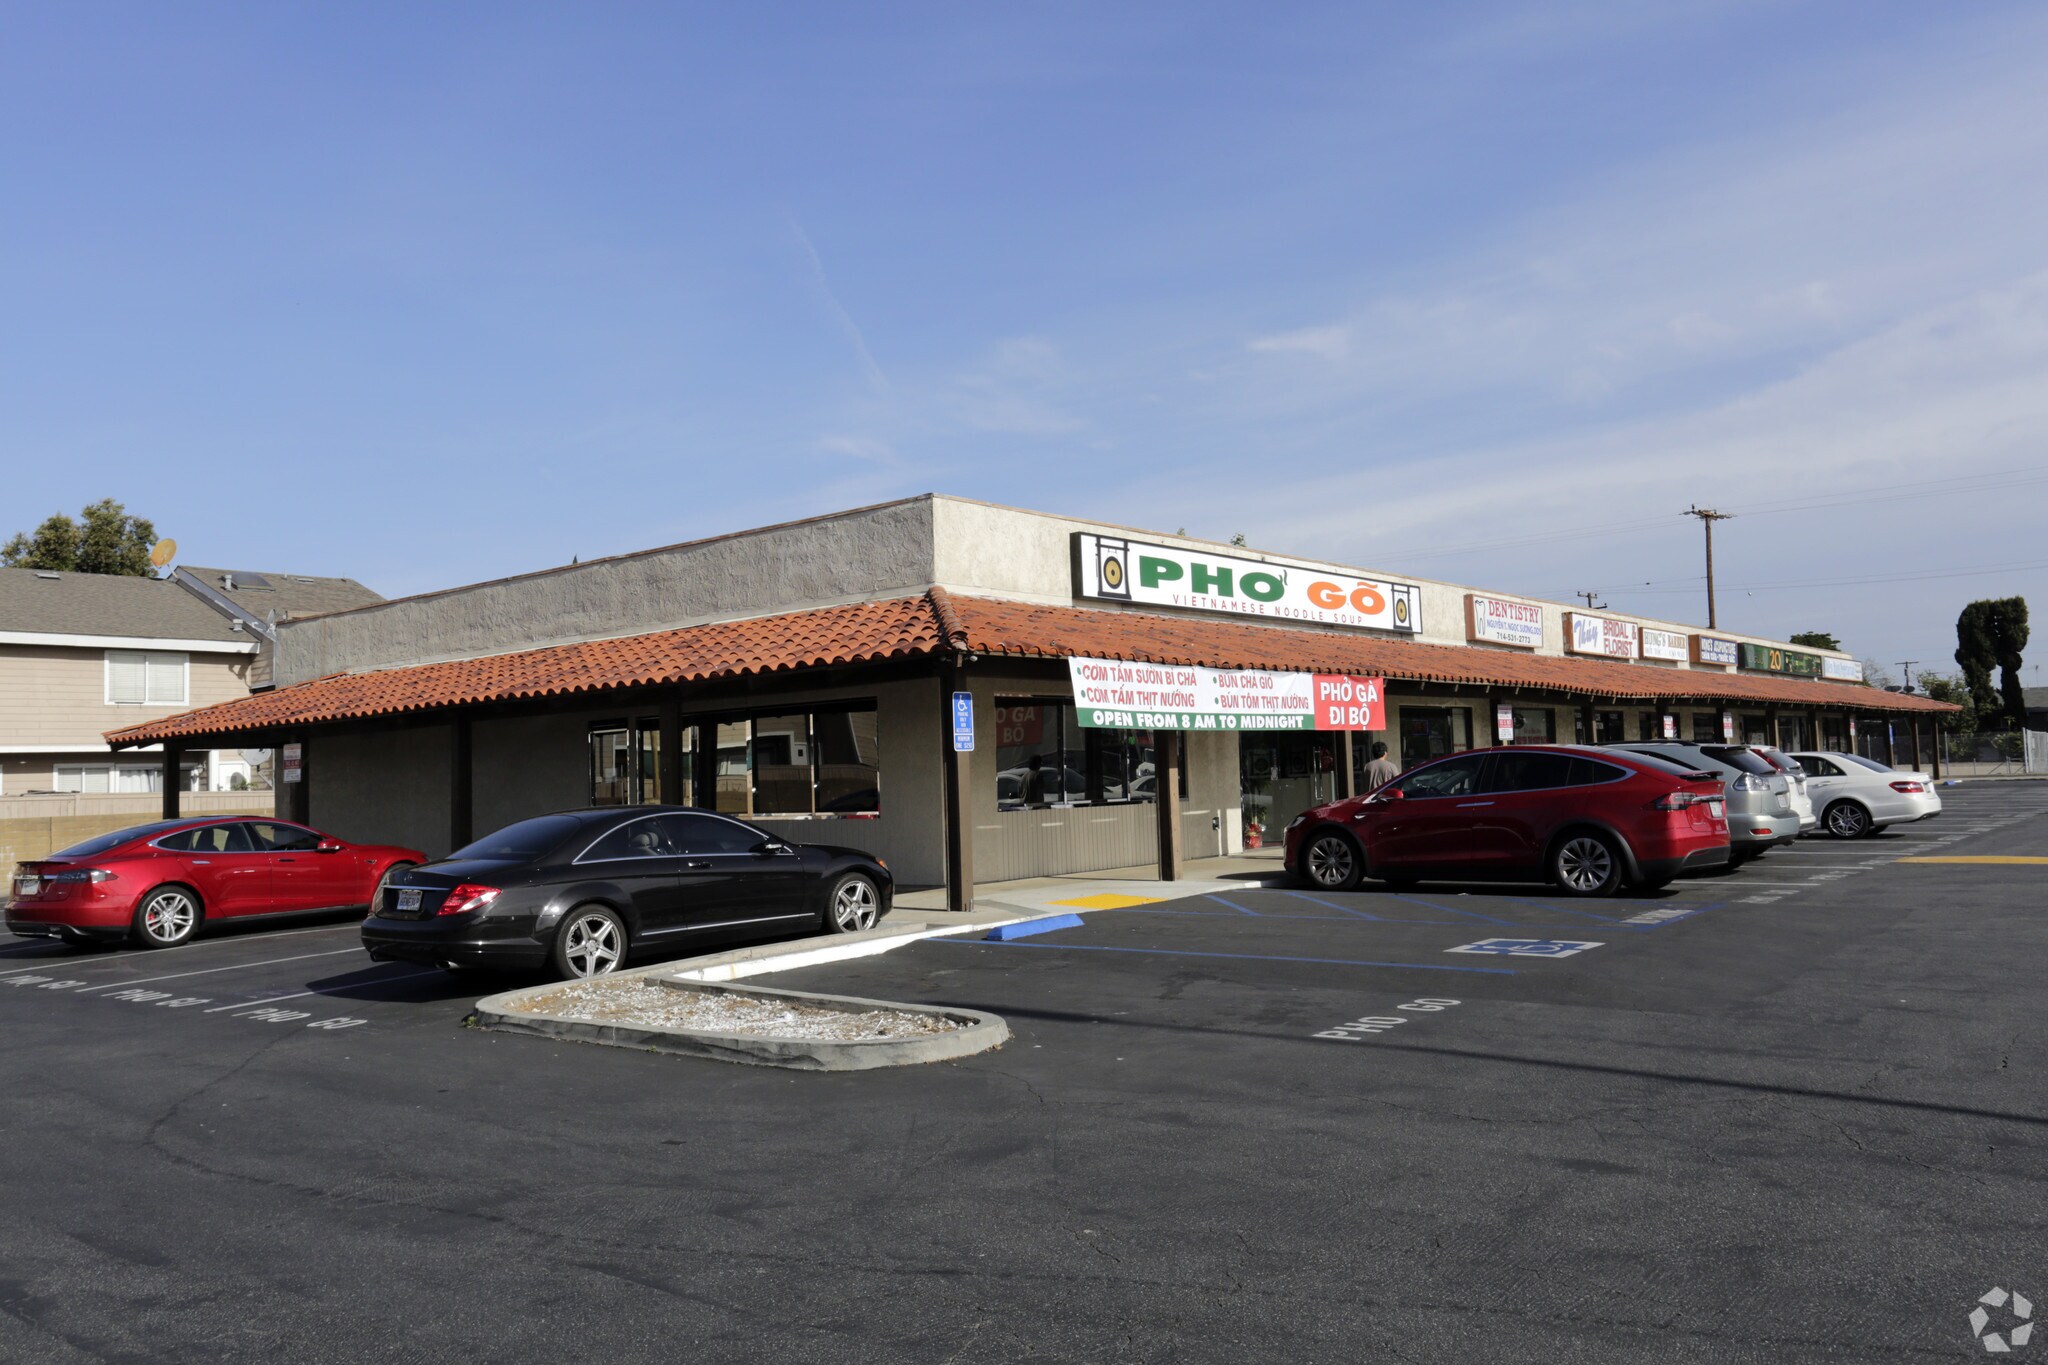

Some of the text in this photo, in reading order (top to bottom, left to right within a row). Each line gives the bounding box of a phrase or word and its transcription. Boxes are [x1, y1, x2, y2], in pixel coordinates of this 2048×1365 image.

[1173, 594, 1362, 624] VIETNAMESE NOODLE SOUP
[1488, 600, 1539, 623] DENTISTRY
[1603, 620, 1636, 640] BRIDAL &
[1604, 638, 1633, 656] FLORIST
[1769, 650, 1781, 670] 20
[1356, 680, 1378, 702] GÀ
[1093, 710, 1304, 729] OPEN FROM 8 AM TO MIDNIGHT
[1329, 703, 1370, 730] ĐI BỘ
[231, 1007, 368, 1030] PHO GO
[1312, 998, 1461, 1040] PHO GO
